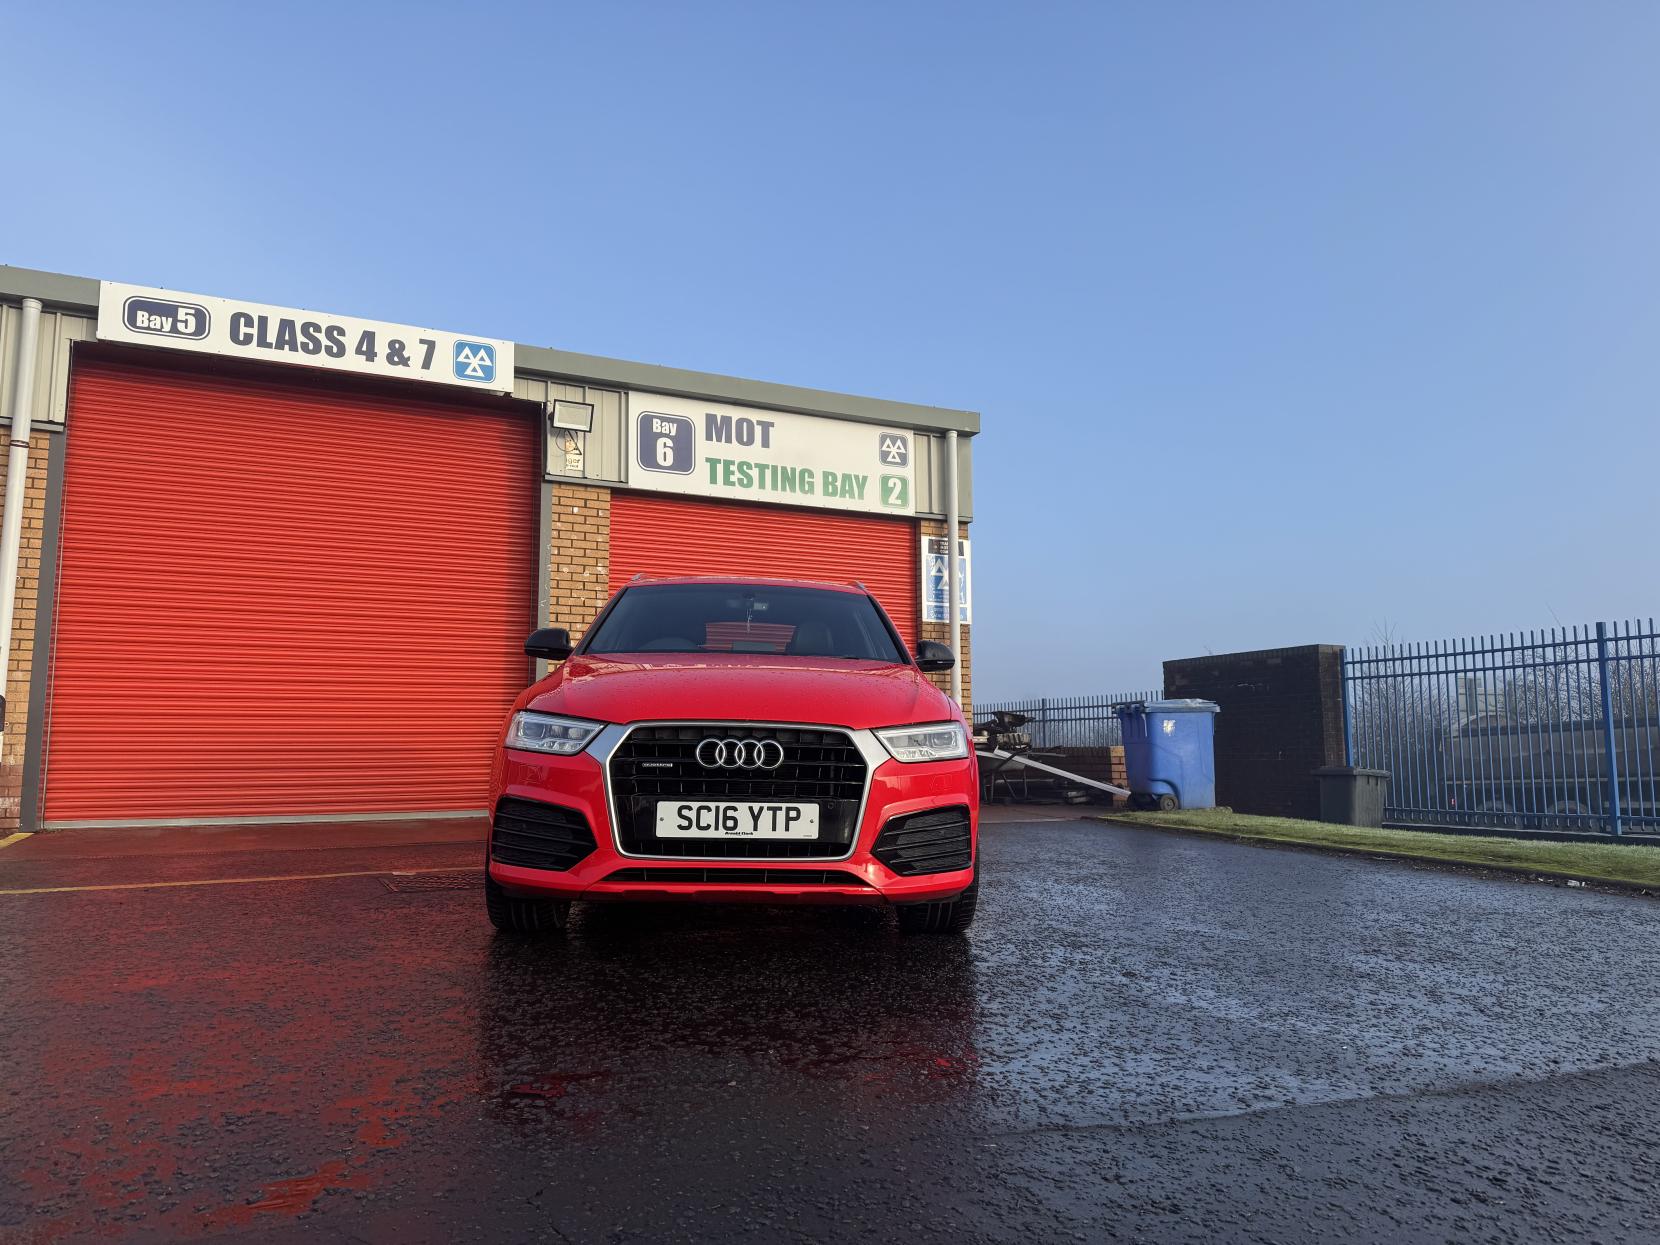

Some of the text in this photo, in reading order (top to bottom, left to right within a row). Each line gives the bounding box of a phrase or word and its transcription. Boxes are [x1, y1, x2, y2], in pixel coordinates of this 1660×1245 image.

[136, 307, 197, 335] Bay 5
[229, 311, 436, 370] CLASS 4 & 7
[652, 418, 677, 437] Bay
[705, 412, 775, 449] MOT
[656, 436, 674, 467] 6
[705, 457, 869, 501] TESTING BAY
[887, 477, 902, 505] 2
[748, 805, 801, 832] YTP
